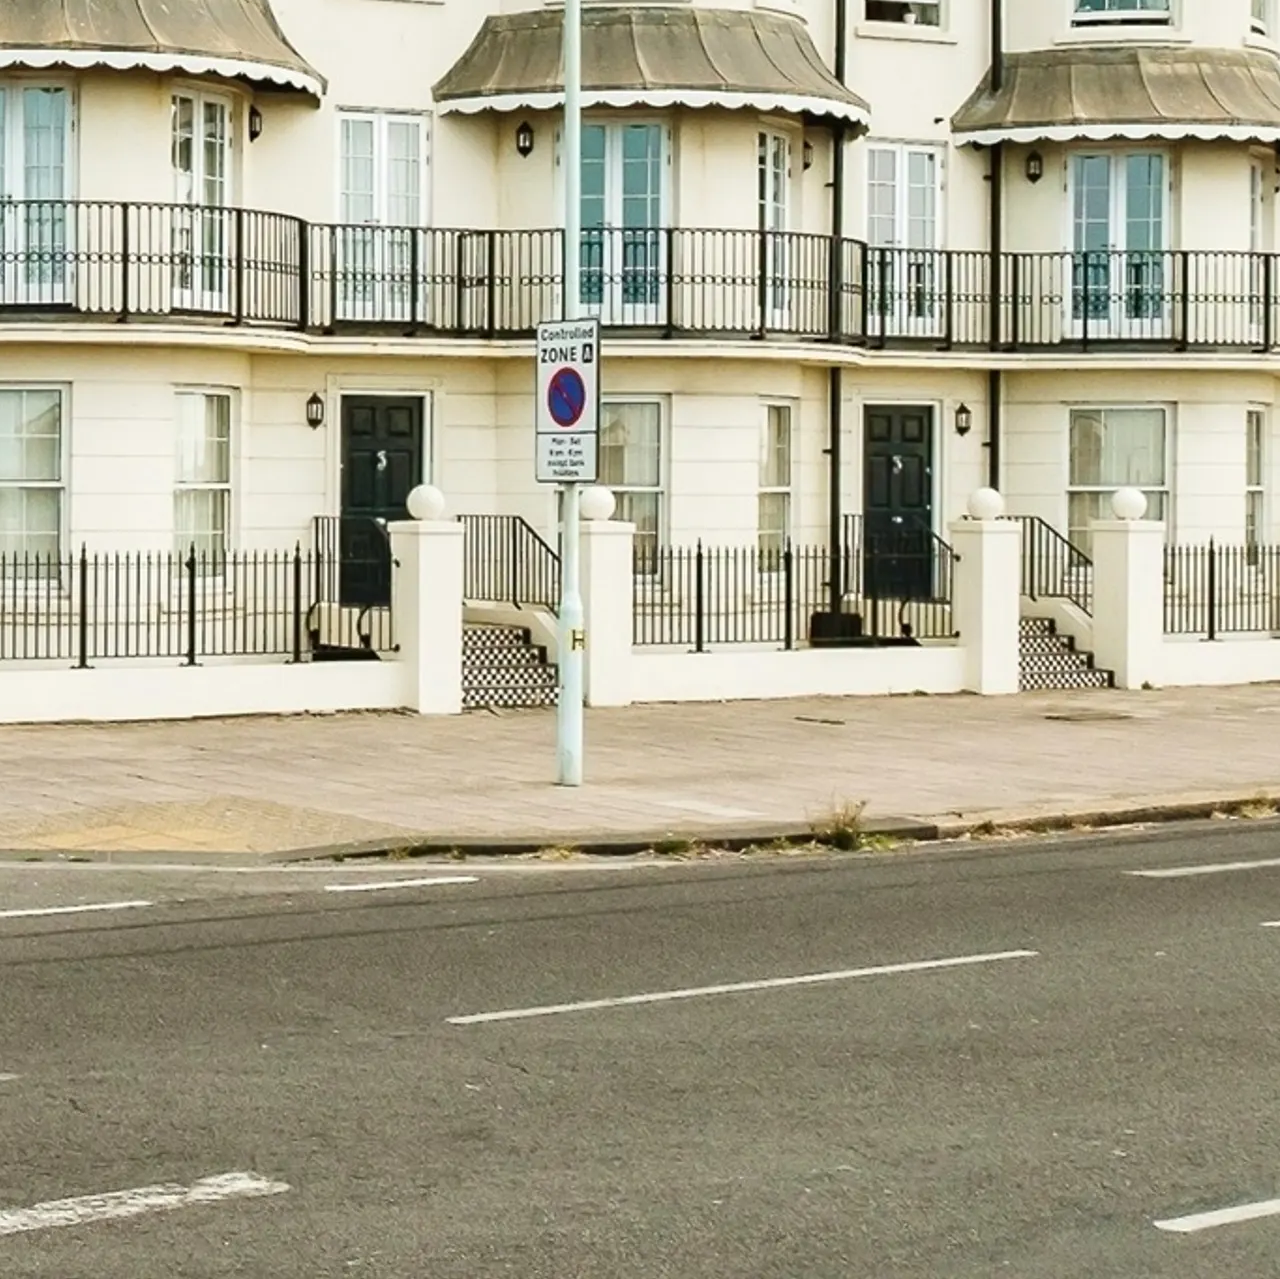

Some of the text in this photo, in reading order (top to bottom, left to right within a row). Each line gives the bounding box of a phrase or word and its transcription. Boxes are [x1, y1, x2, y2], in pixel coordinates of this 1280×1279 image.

[541, 326, 594, 341] Controlled
[541, 346, 577, 363] ZONE
[572, 629, 585, 650] H
